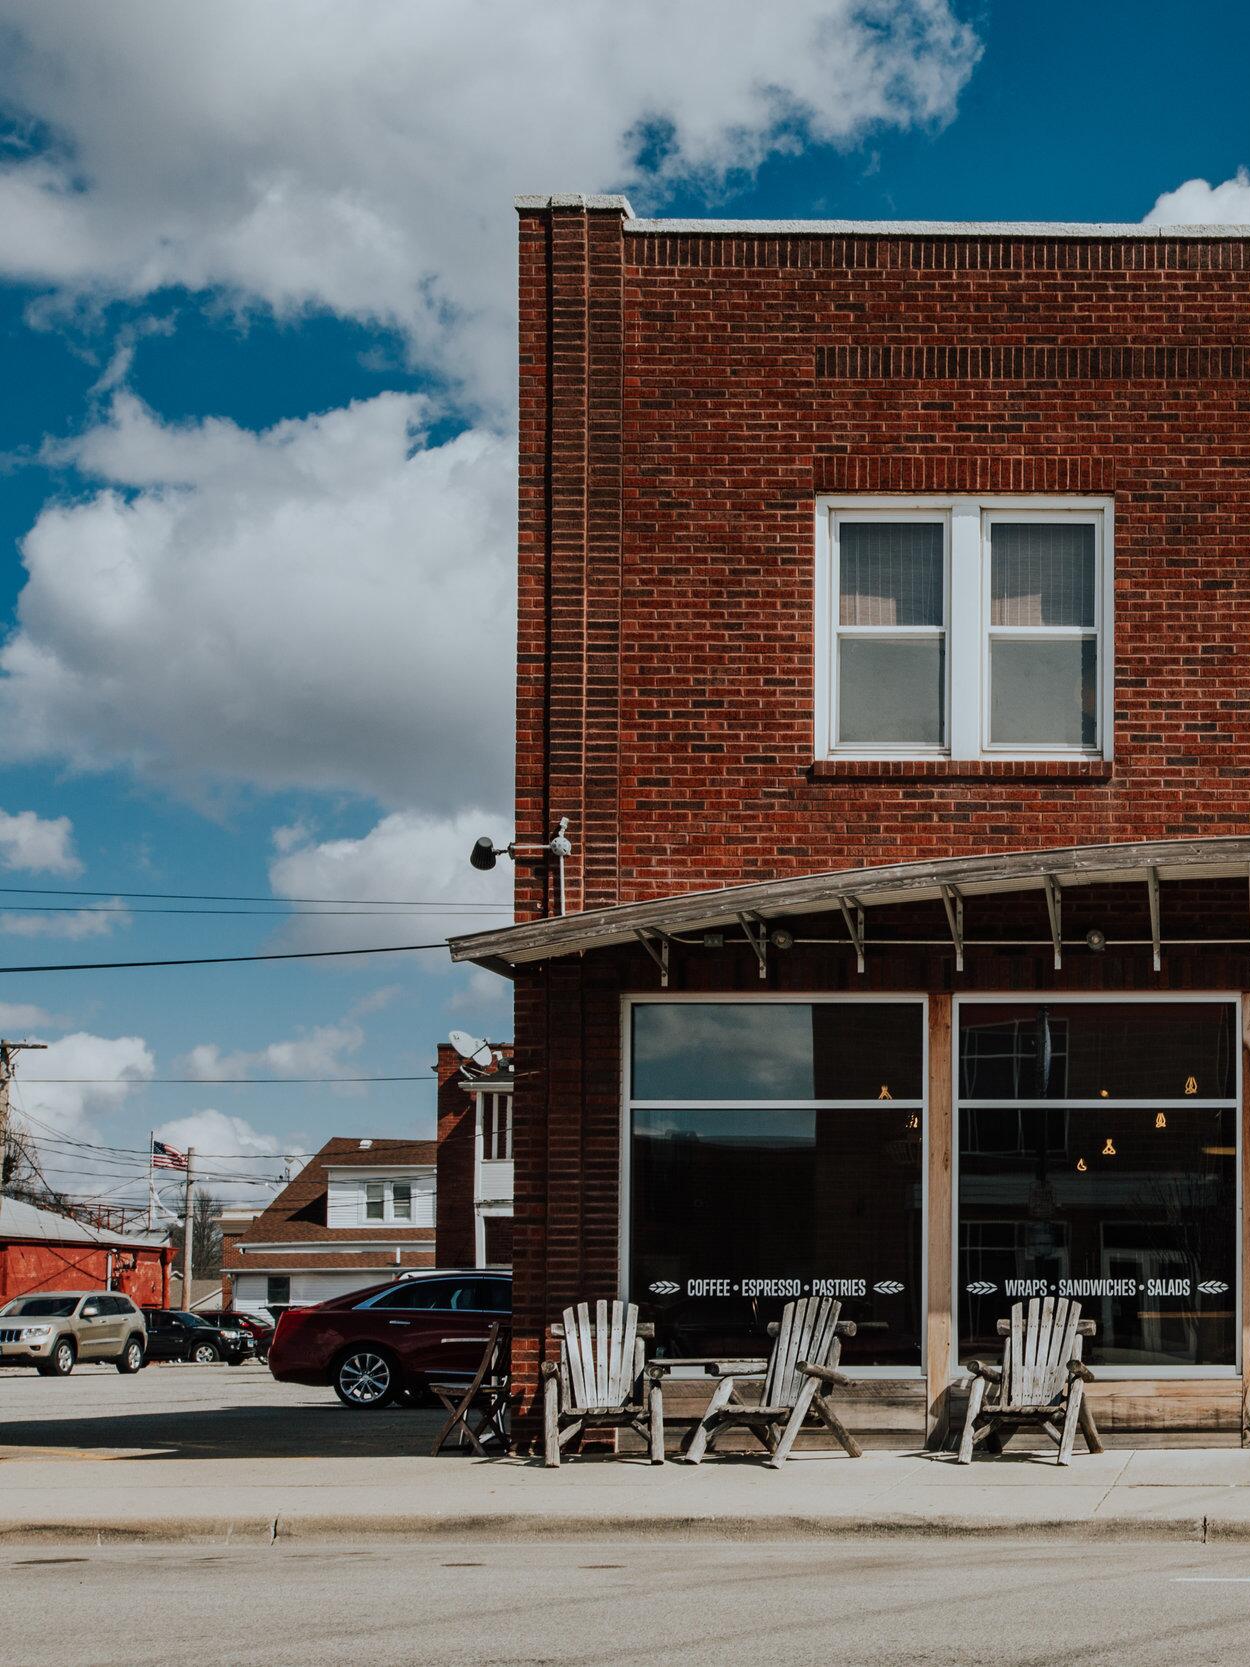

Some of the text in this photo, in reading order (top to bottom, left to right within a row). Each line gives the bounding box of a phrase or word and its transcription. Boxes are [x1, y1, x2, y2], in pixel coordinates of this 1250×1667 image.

[687, 1279, 866, 1296] COFFEE ESPRESSO PASTRIES
[1005, 1278, 1191, 1296] WRAPS SANDWICHES SALADS
